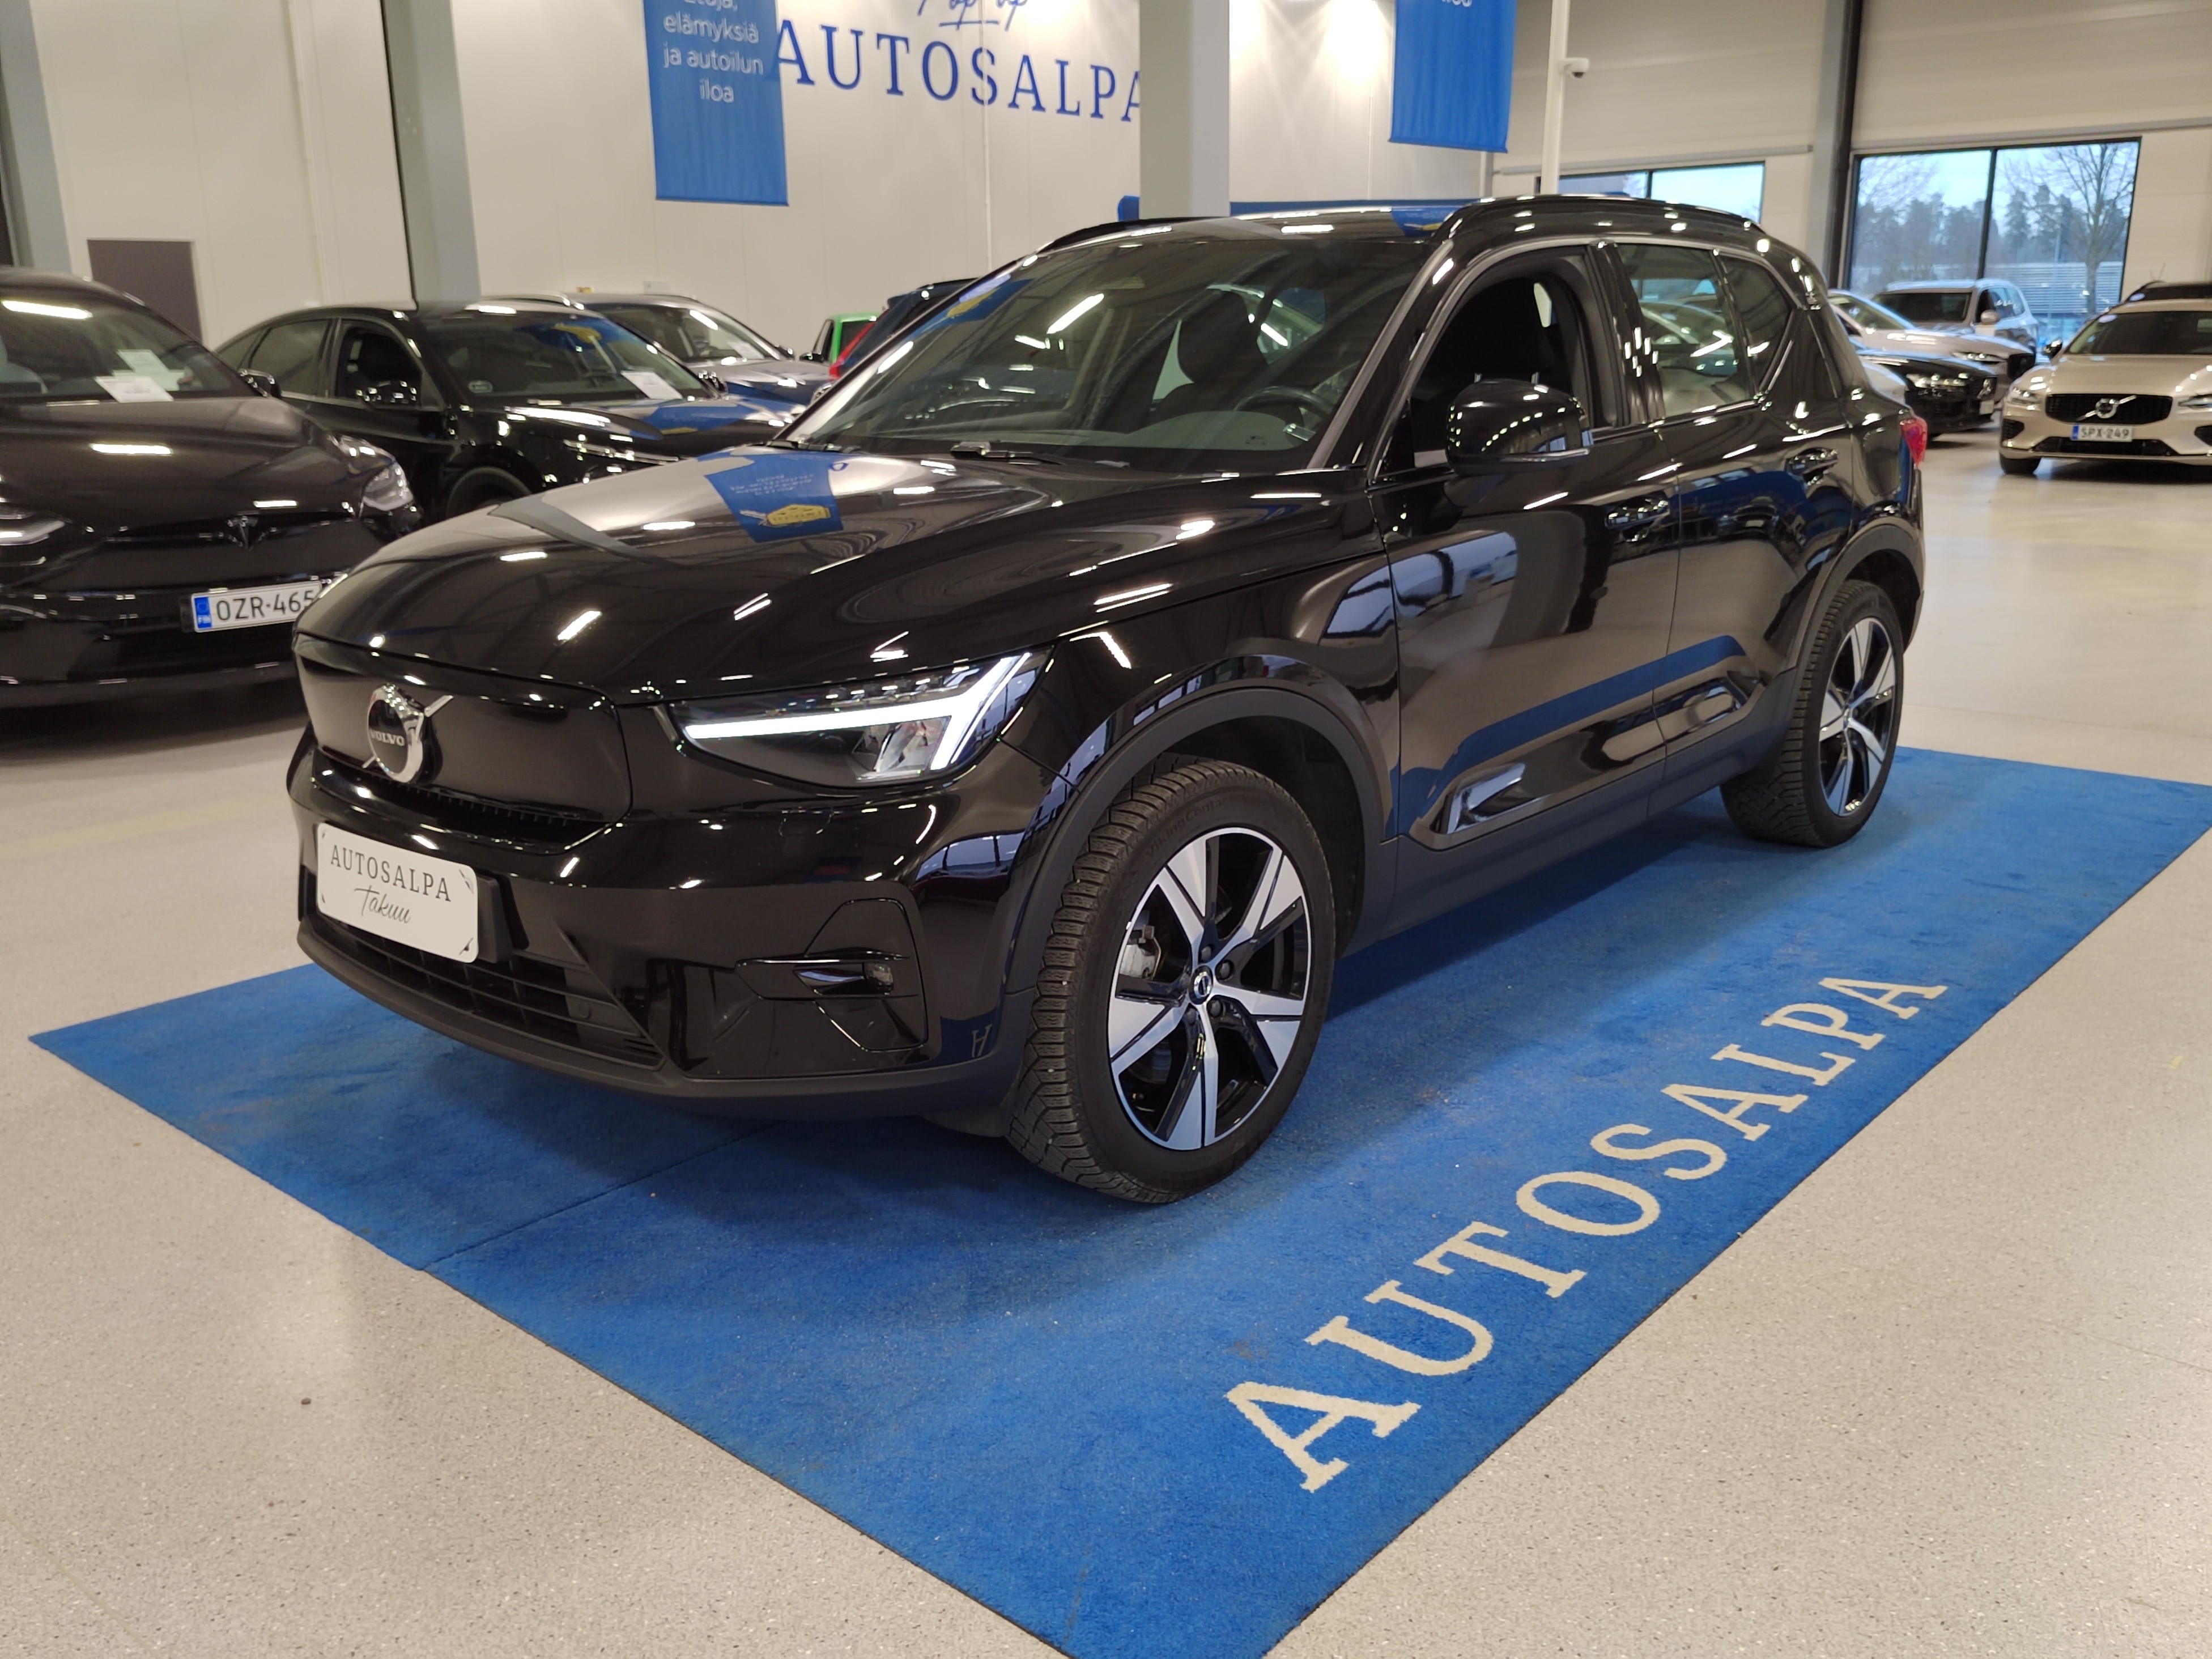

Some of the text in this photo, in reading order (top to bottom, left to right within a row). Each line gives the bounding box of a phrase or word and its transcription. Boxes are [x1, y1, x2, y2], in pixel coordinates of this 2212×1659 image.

[663, 11, 759, 44] elämyksiä
[663, 41, 764, 75] ja autoilun
[700, 78, 734, 103] iloa
[369, 730, 406, 747] VOLVO
[330, 844, 452, 902] AUTOSALPA
[354, 884, 411, 924] Takuu
[1223, 976, 1948, 1494] AUTOSALPA
